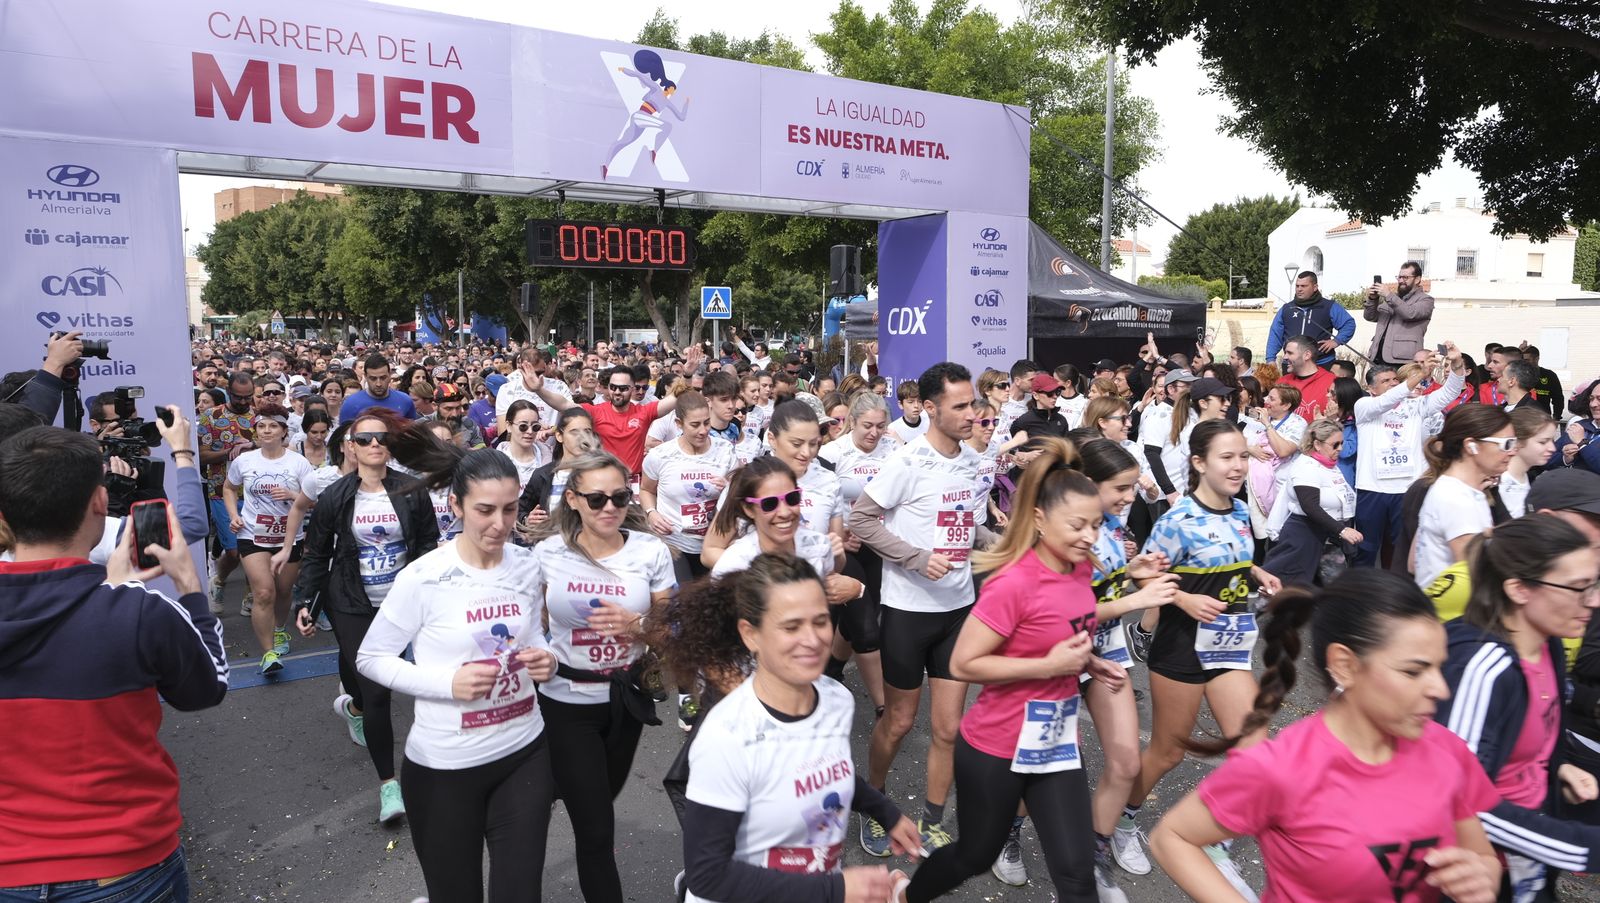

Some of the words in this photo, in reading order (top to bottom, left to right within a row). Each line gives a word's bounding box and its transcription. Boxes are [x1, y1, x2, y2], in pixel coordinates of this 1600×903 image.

[207, 11, 367, 58] CARRERA
[377, 35, 417, 65] DE
[428, 42, 463, 71] LA
[191, 51, 480, 144] MUJER
[816, 97, 838, 117] LA
[842, 101, 926, 129] IGUALDAD
[787, 124, 811, 145] ES
[815, 127, 897, 155] NUESTRA
[899, 138, 950, 161] META.
[27, 188, 121, 204] HYUNDAI
[41, 202, 112, 216] Almerialva
[54, 231, 130, 248] cajamar
[972, 242, 1008, 251] HYUNDAI
[981, 267, 1009, 277] cajamar
[41, 275, 108, 297] CASI
[66, 312, 134, 329] vithas
[982, 316, 1008, 326] vithas
[103, 329, 135, 337] cuidarte
[976, 346, 1006, 358] aqualia
[1381, 454, 1409, 465] 1369
[942, 489, 972, 504] MUJER
[355, 513, 398, 525] MUJER
[947, 527, 970, 542] 995
[367, 555, 397, 571] 175
[567, 582, 627, 597] MUJER
[466, 603, 522, 624] MUJER
[1212, 632, 1245, 646] 375
[588, 644, 631, 664] 992
[794, 760, 851, 798] MUJER
